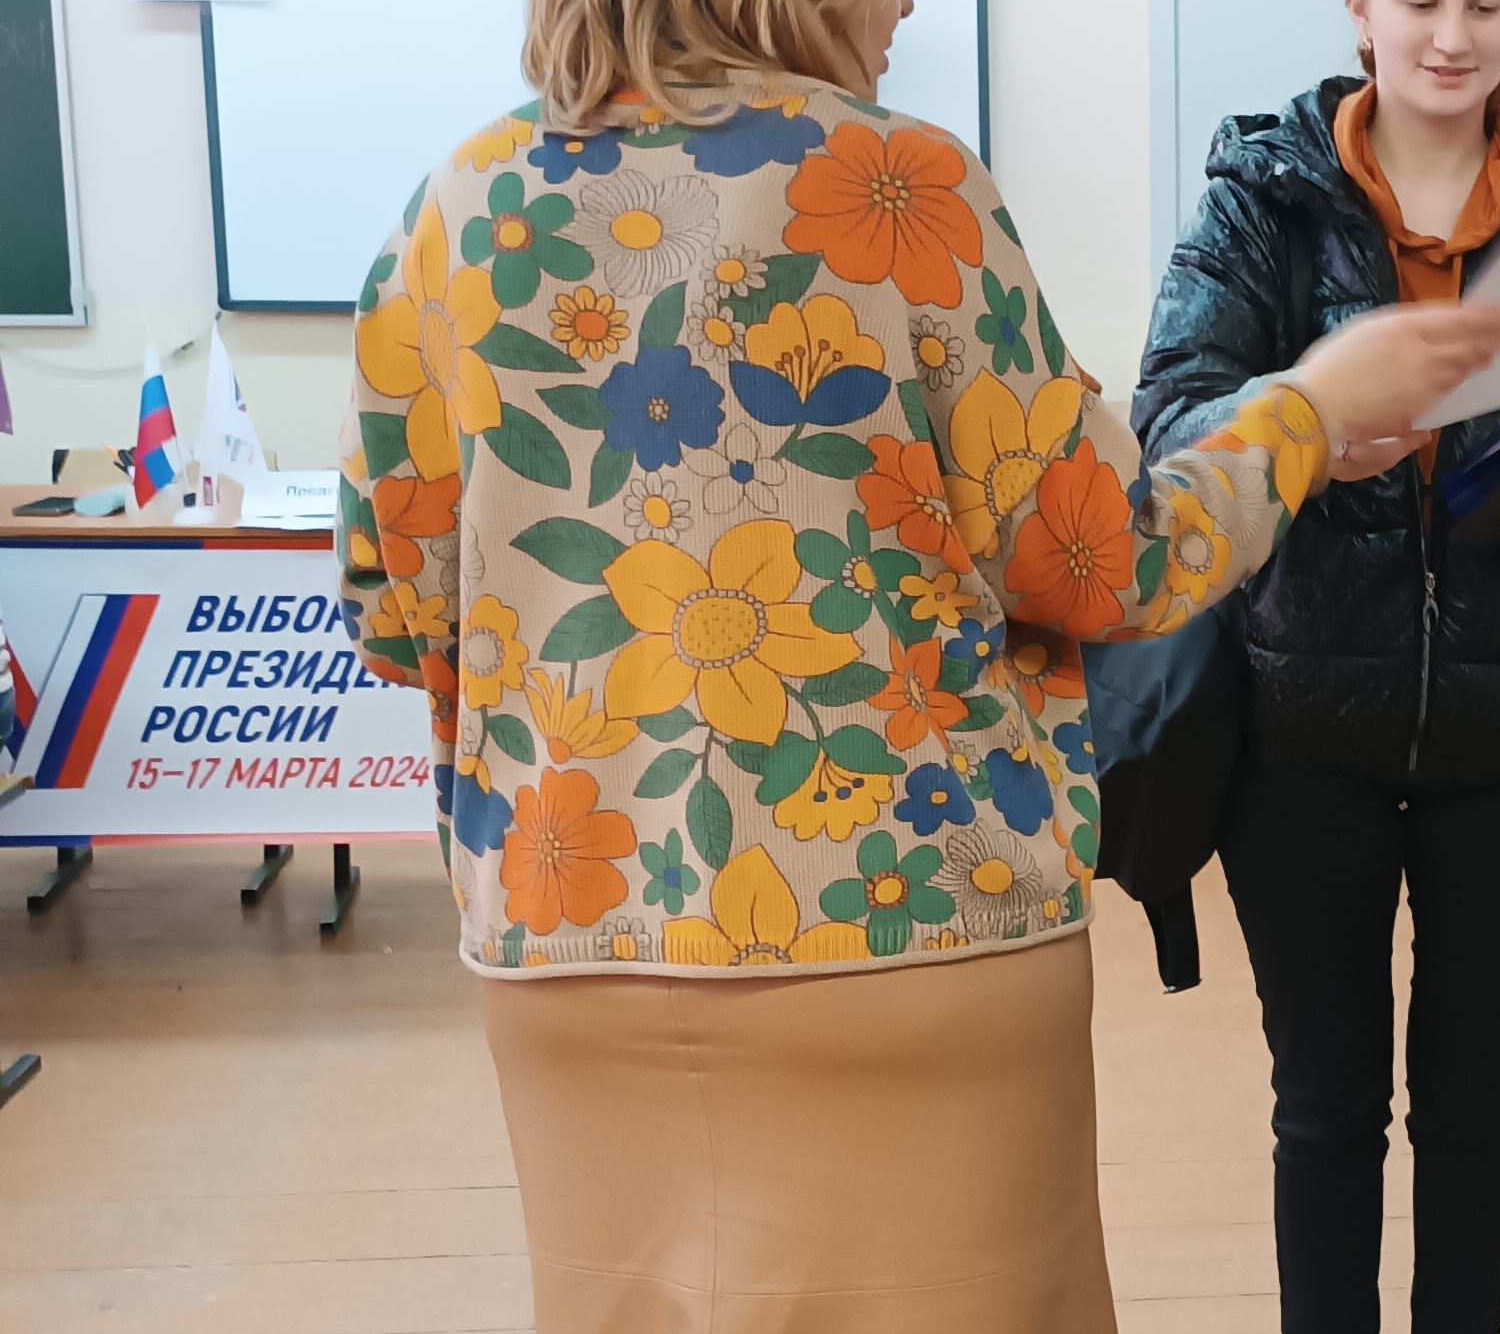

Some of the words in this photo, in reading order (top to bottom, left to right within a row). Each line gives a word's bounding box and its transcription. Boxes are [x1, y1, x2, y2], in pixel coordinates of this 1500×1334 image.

[141, 705, 339, 744] РОССИИ
[225, 757, 341, 789] МАРТА
[348, 755, 430, 788] 2024
